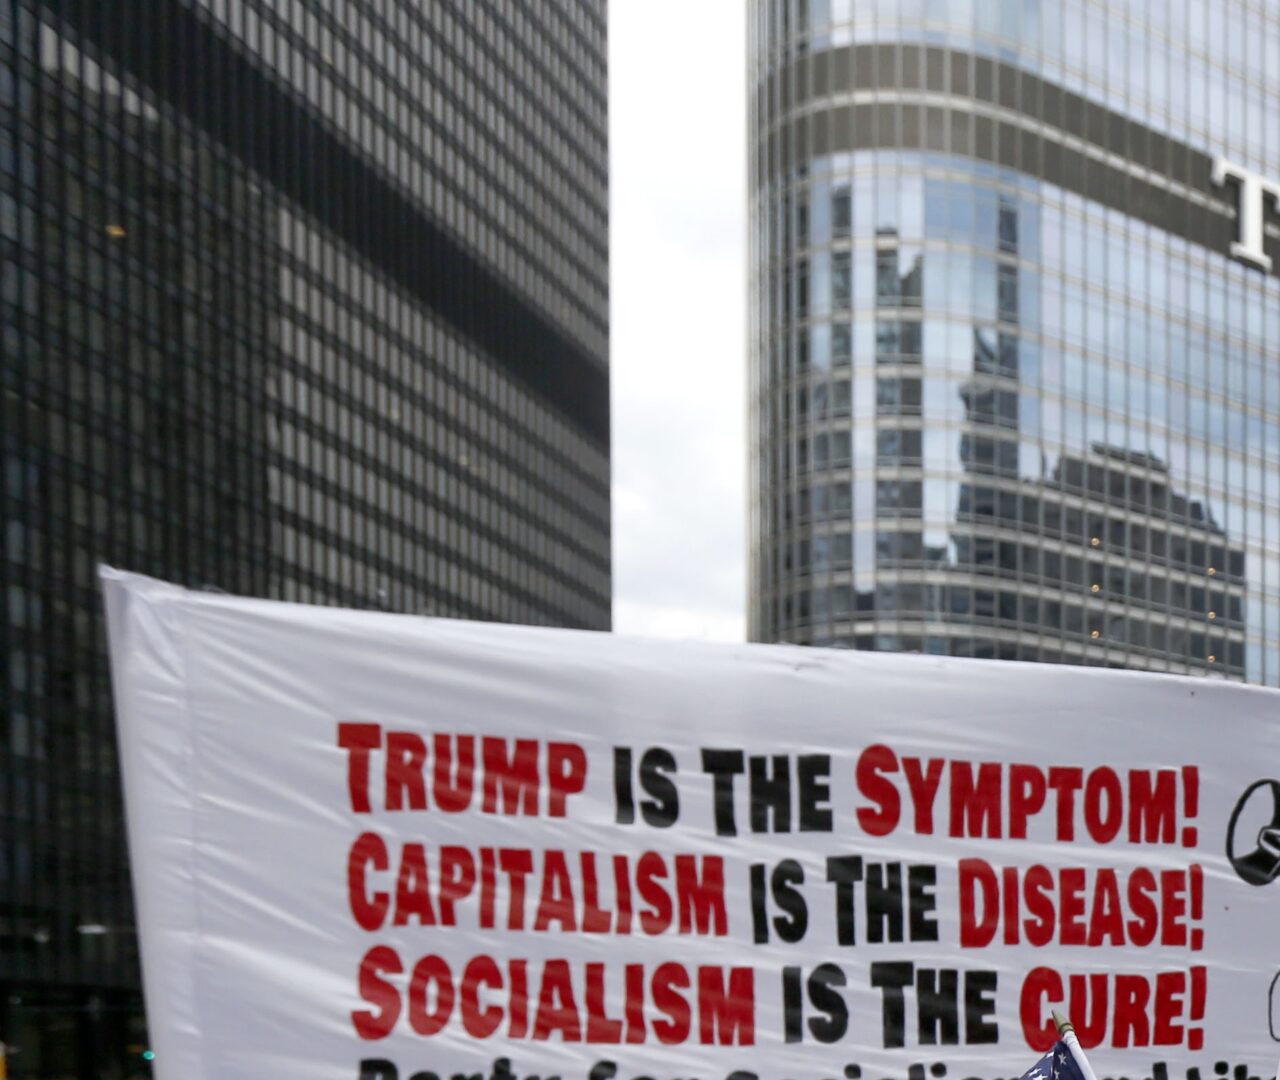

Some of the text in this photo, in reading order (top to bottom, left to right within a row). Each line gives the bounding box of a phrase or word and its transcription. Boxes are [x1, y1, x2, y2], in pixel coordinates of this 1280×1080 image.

[337, 722, 1199, 848] TRUMP IS THE SYMPTOM!
[347, 831, 1204, 951] CAPITALISM IS THE DISEASE!
[351, 944, 1208, 1053] SOCIALISM IS THE CURE!
